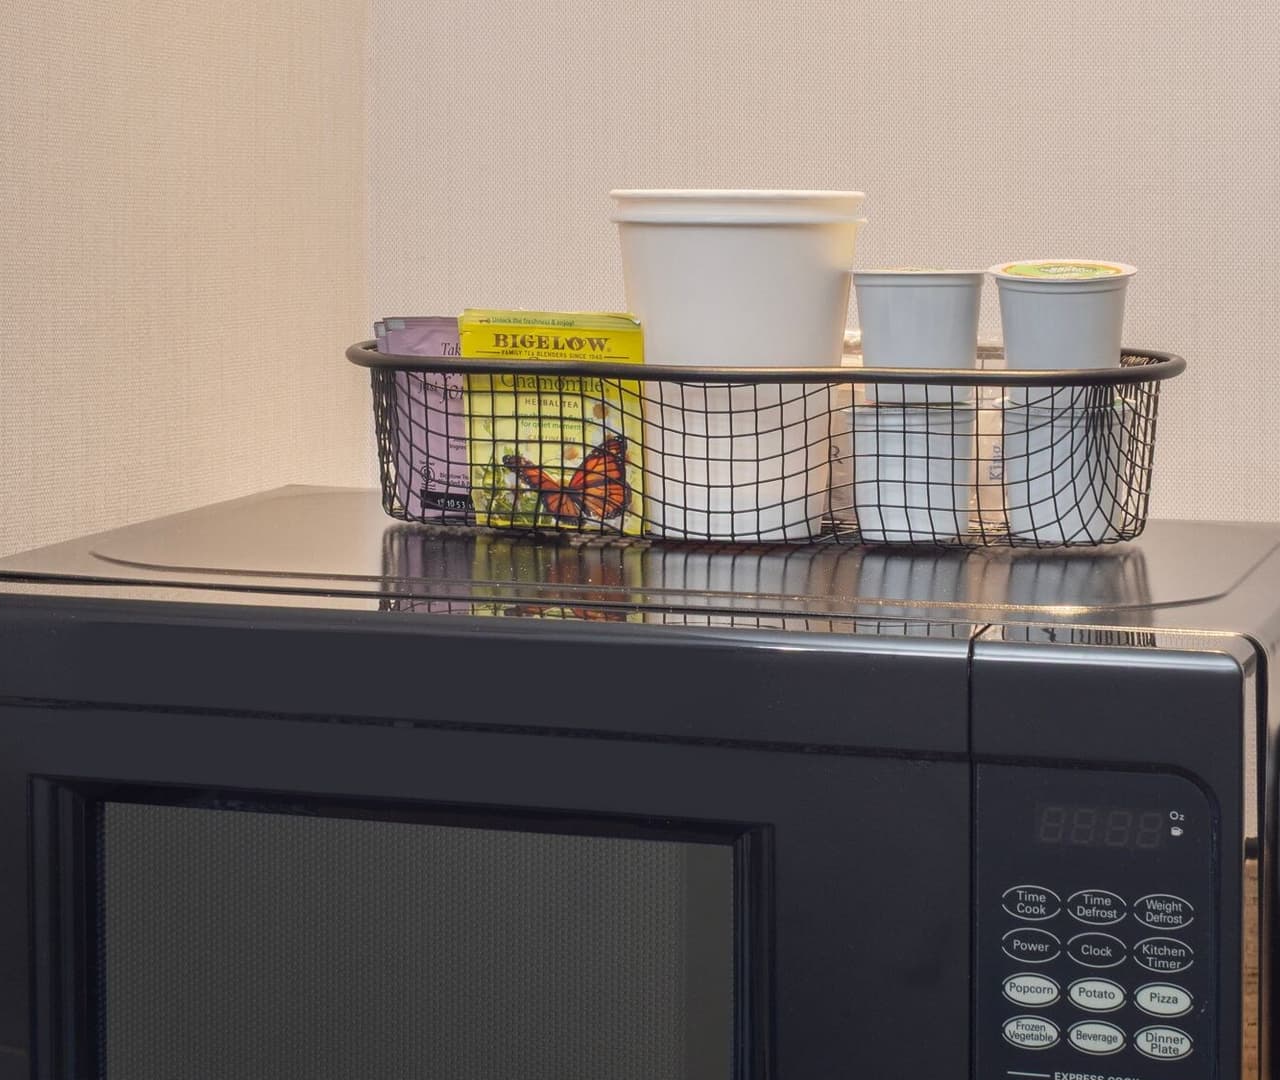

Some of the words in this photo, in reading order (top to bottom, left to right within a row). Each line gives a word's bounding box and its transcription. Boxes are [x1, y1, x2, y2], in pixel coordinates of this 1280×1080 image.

[494, 333, 611, 352] BIGELOW
[525, 399, 560, 408] HEBAL
[1017, 890, 1046, 902] Time
[1083, 894, 1111, 906] Time
[1016, 903, 1046, 915] Cook
[1146, 899, 1182, 913] Weight
[1077, 906, 1117, 919] Defrost
[1145, 912, 1183, 924] Defrost
[1013, 939, 1050, 952] Power
[1081, 945, 1112, 957] Clock
[1142, 944, 1186, 957] Kitchen
[1146, 957, 1182, 969] Timer
[1009, 982, 1054, 995] Popcorn
[1078, 987, 1115, 1000] Potato
[1150, 993, 1179, 1005] Pizza
[1016, 1021, 1046, 1032] Frozen
[1008, 1031, 1053, 1043] Vegetable
[1076, 1030, 1118, 1044] Beverage
[1145, 1032, 1185, 1045] Dinner
[1151, 1043, 1179, 1055] Plate
